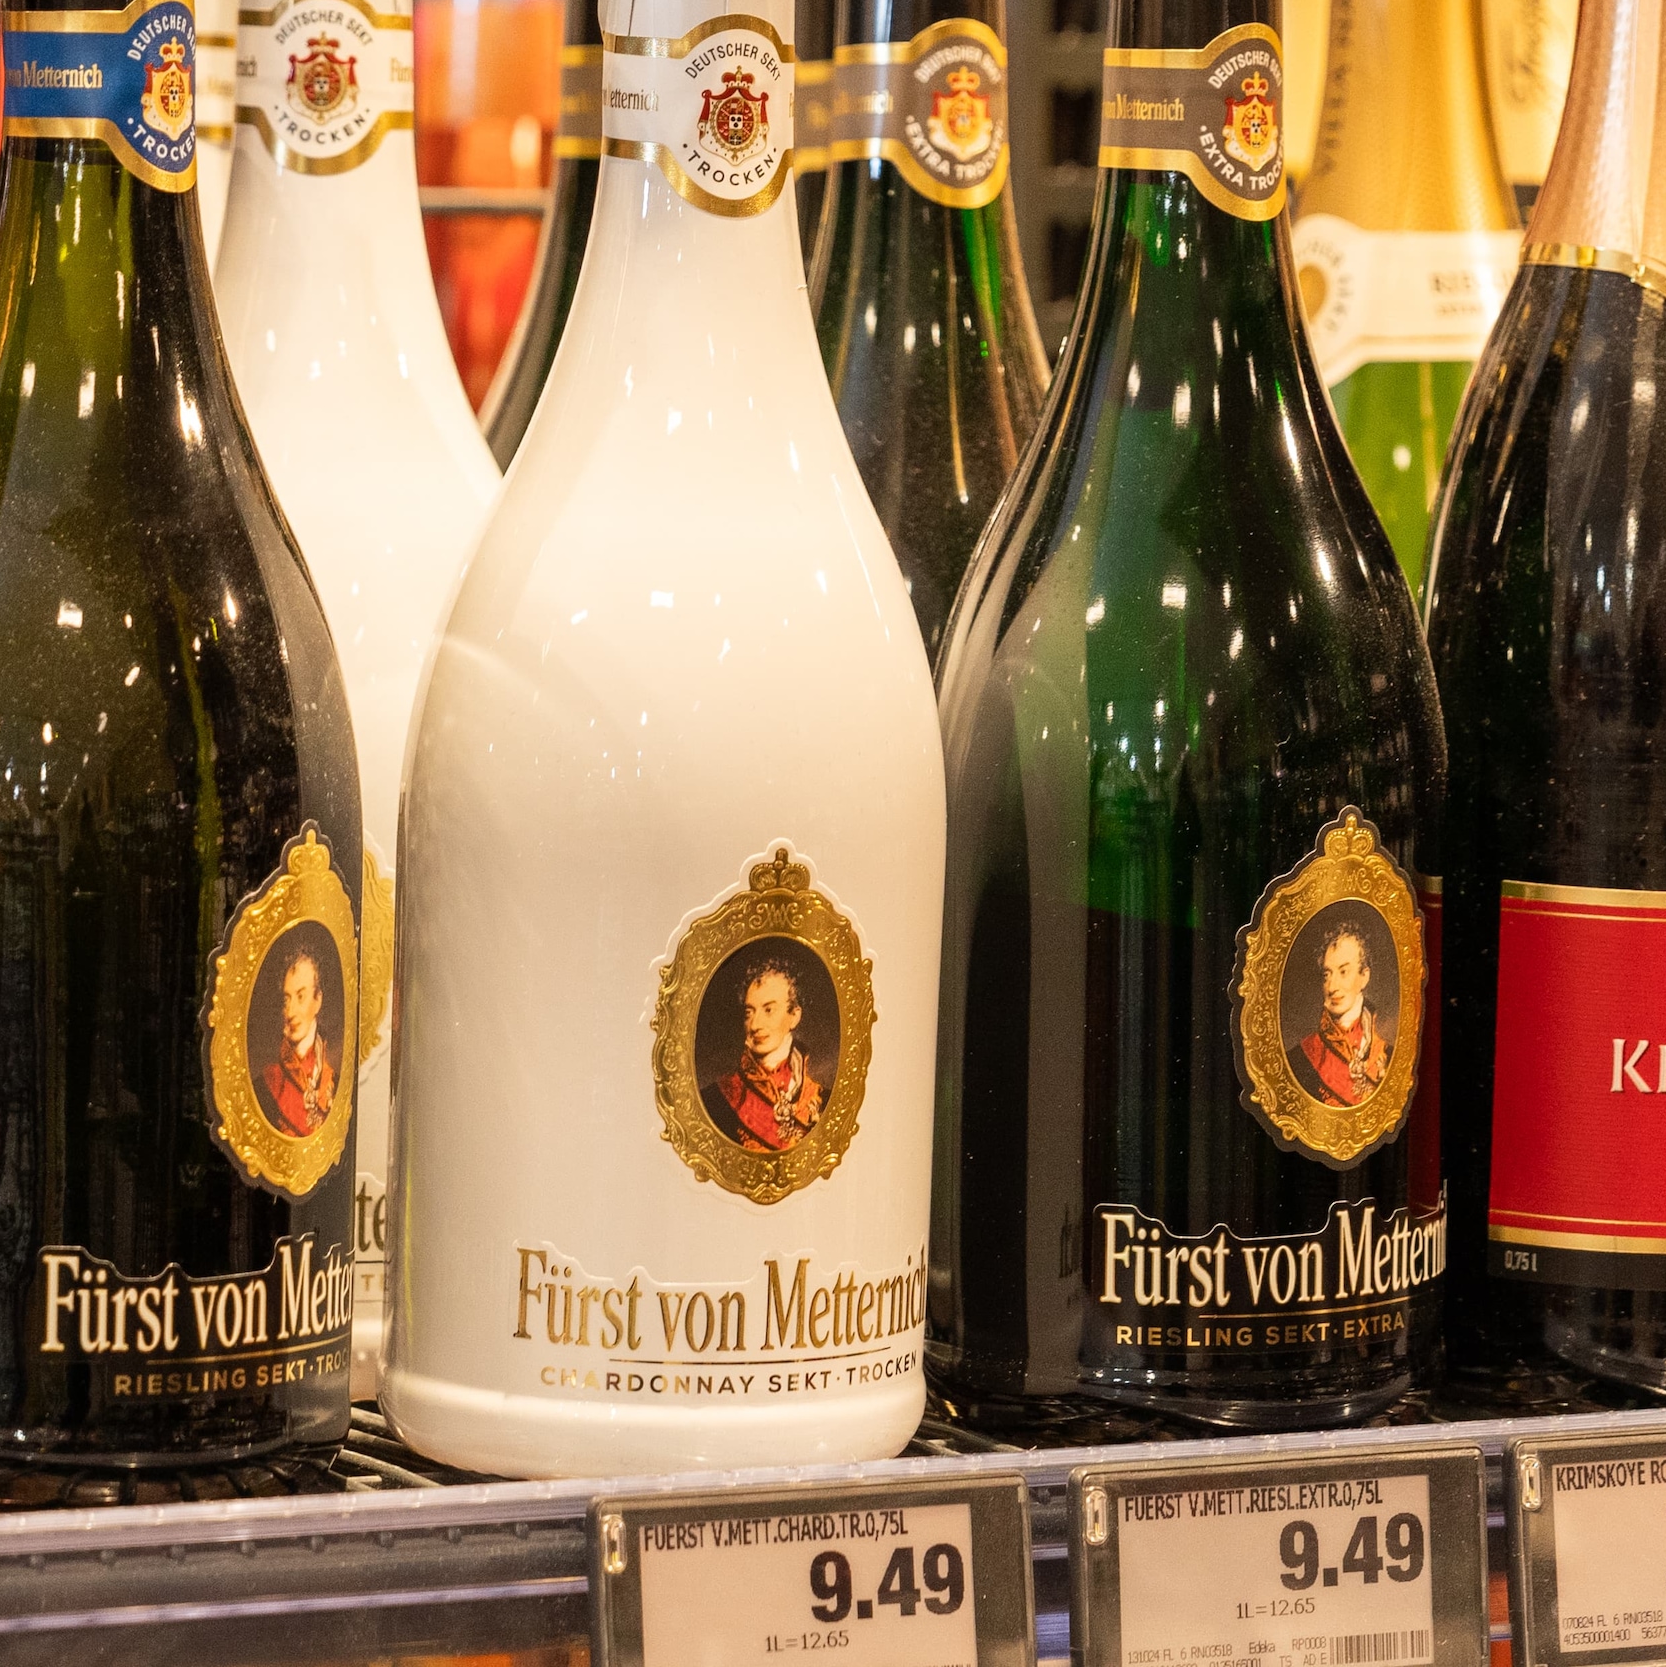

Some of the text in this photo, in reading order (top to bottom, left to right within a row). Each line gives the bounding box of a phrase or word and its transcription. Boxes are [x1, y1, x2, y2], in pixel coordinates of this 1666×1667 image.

[127, 14, 187, 62] DEUTSCHER
[275, 10, 374, 46] DEUTSCHER SEKT
[22, 60, 103, 89] Metternich
[684, 42, 781, 82] DEUTSCHER SEKT
[1207, 49, 1270, 90] DEUTSCHER
[1116, 93, 1185, 122] Metternich
[132, 123, 197, 162] TROCKEN
[277, 111, 366, 145] TROCKEN
[687, 149, 774, 187] TROCKEN
[1199, 131, 1244, 188] EXTRA
[1099, 1211, 1230, 1306] Fürst
[1241, 1241, 1325, 1304] von
[40, 1240, 353, 1353] Fürst von Metter
[512, 1243, 927, 1353] Fürst von Metternich
[1117, 1313, 1406, 1347] RIESLING SEKT EXTRA
[114, 1367, 248, 1397] RIESLING
[256, 1359, 307, 1388] SEKT
[538, 1351, 918, 1395] CHARDONNAY SEKT TROCKEN
[1555, 1460, 1646, 1492] KRIMSKOYE
[1124, 1494, 1183, 1523] FUERST
[643, 1521, 708, 1553] FUERST
[1279, 1511, 1425, 1592] 9.49
[809, 1542, 967, 1623] 9.49
[1235, 1596, 1317, 1620] 1L=12.65
[764, 1629, 850, 1653] 1L=12.65
[1248, 1640, 1276, 1655] Edeka
